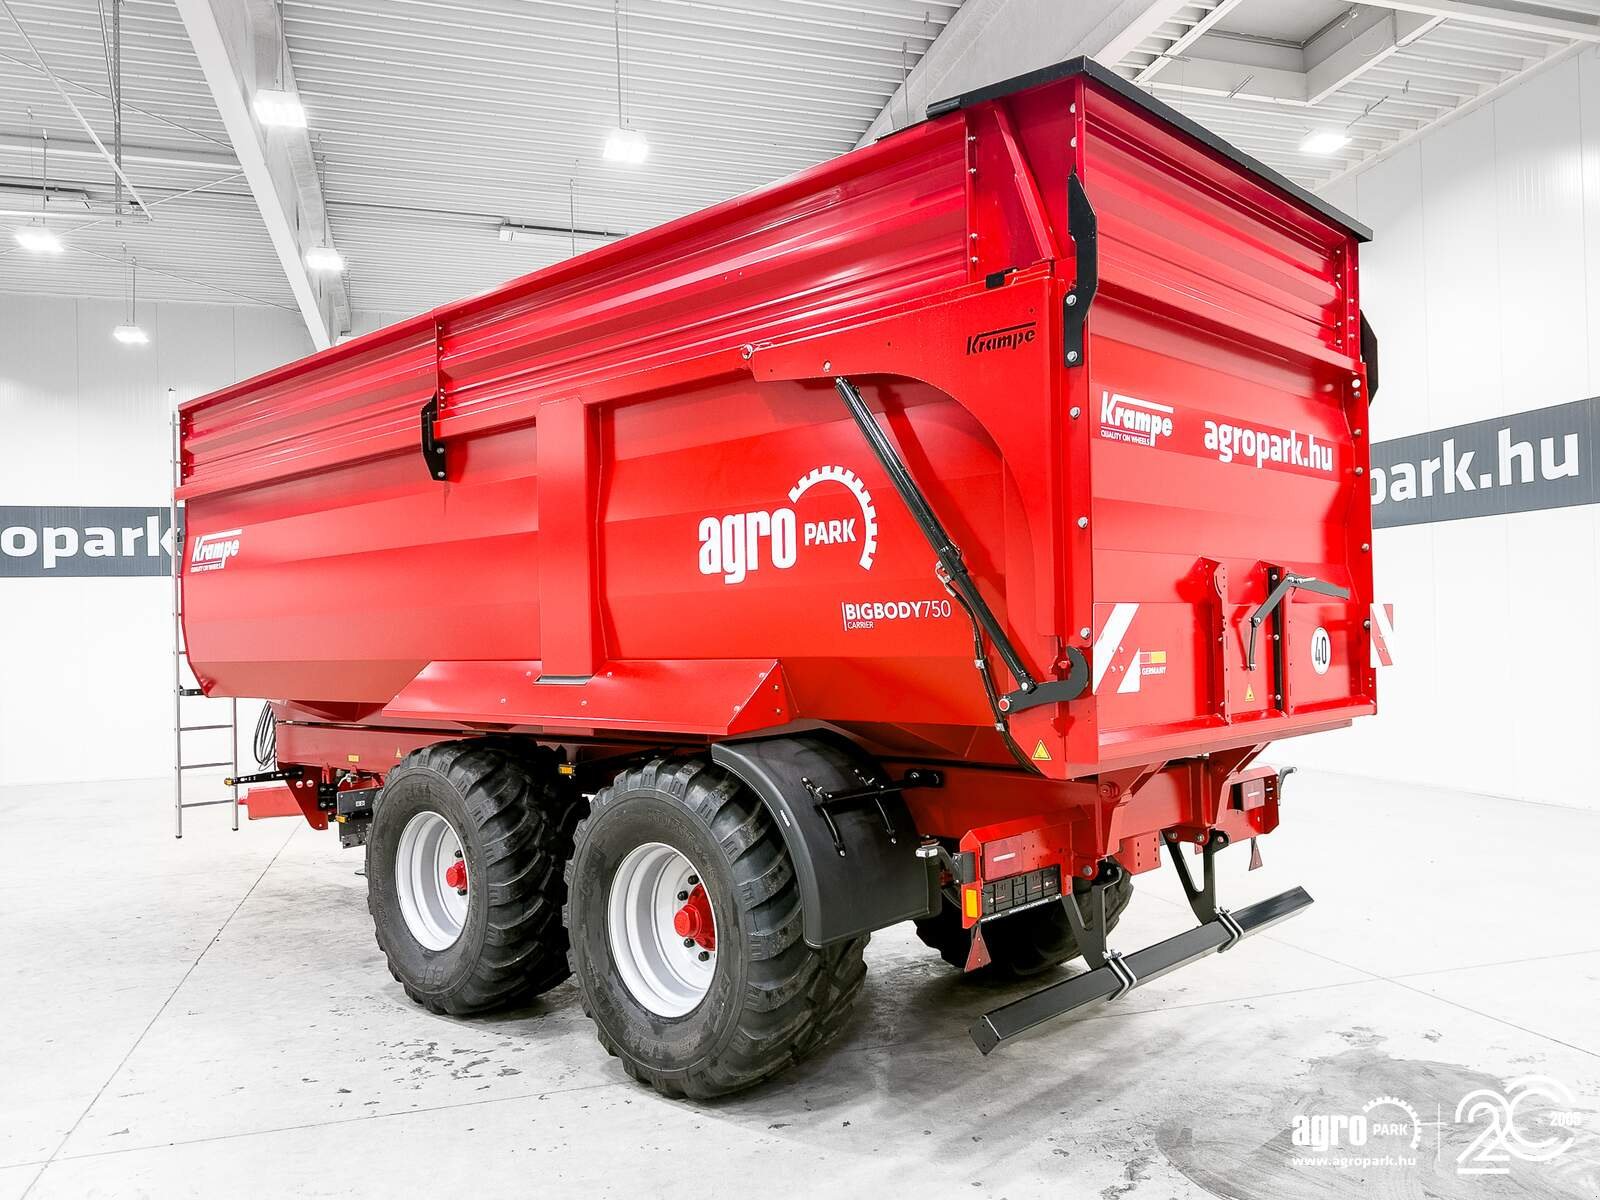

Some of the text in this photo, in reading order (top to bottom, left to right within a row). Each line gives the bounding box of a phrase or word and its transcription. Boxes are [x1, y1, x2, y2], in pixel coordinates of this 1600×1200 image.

[966, 321, 1037, 355] Krampe
[1101, 390, 1174, 447] Krampe
[1101, 429, 1122, 441] QUALITY
[1131, 435, 1150, 446] WHEELS
[1204, 420, 1333, 471] agropark.hu
[698, 508, 797, 585] agro
[804, 518, 857, 546] PARK
[191, 529, 243, 569] Krampe
[845, 600, 951, 620] BIGBODY750
[847, 621, 874, 629] CARRIER
[1315, 636, 1327, 665] 40
